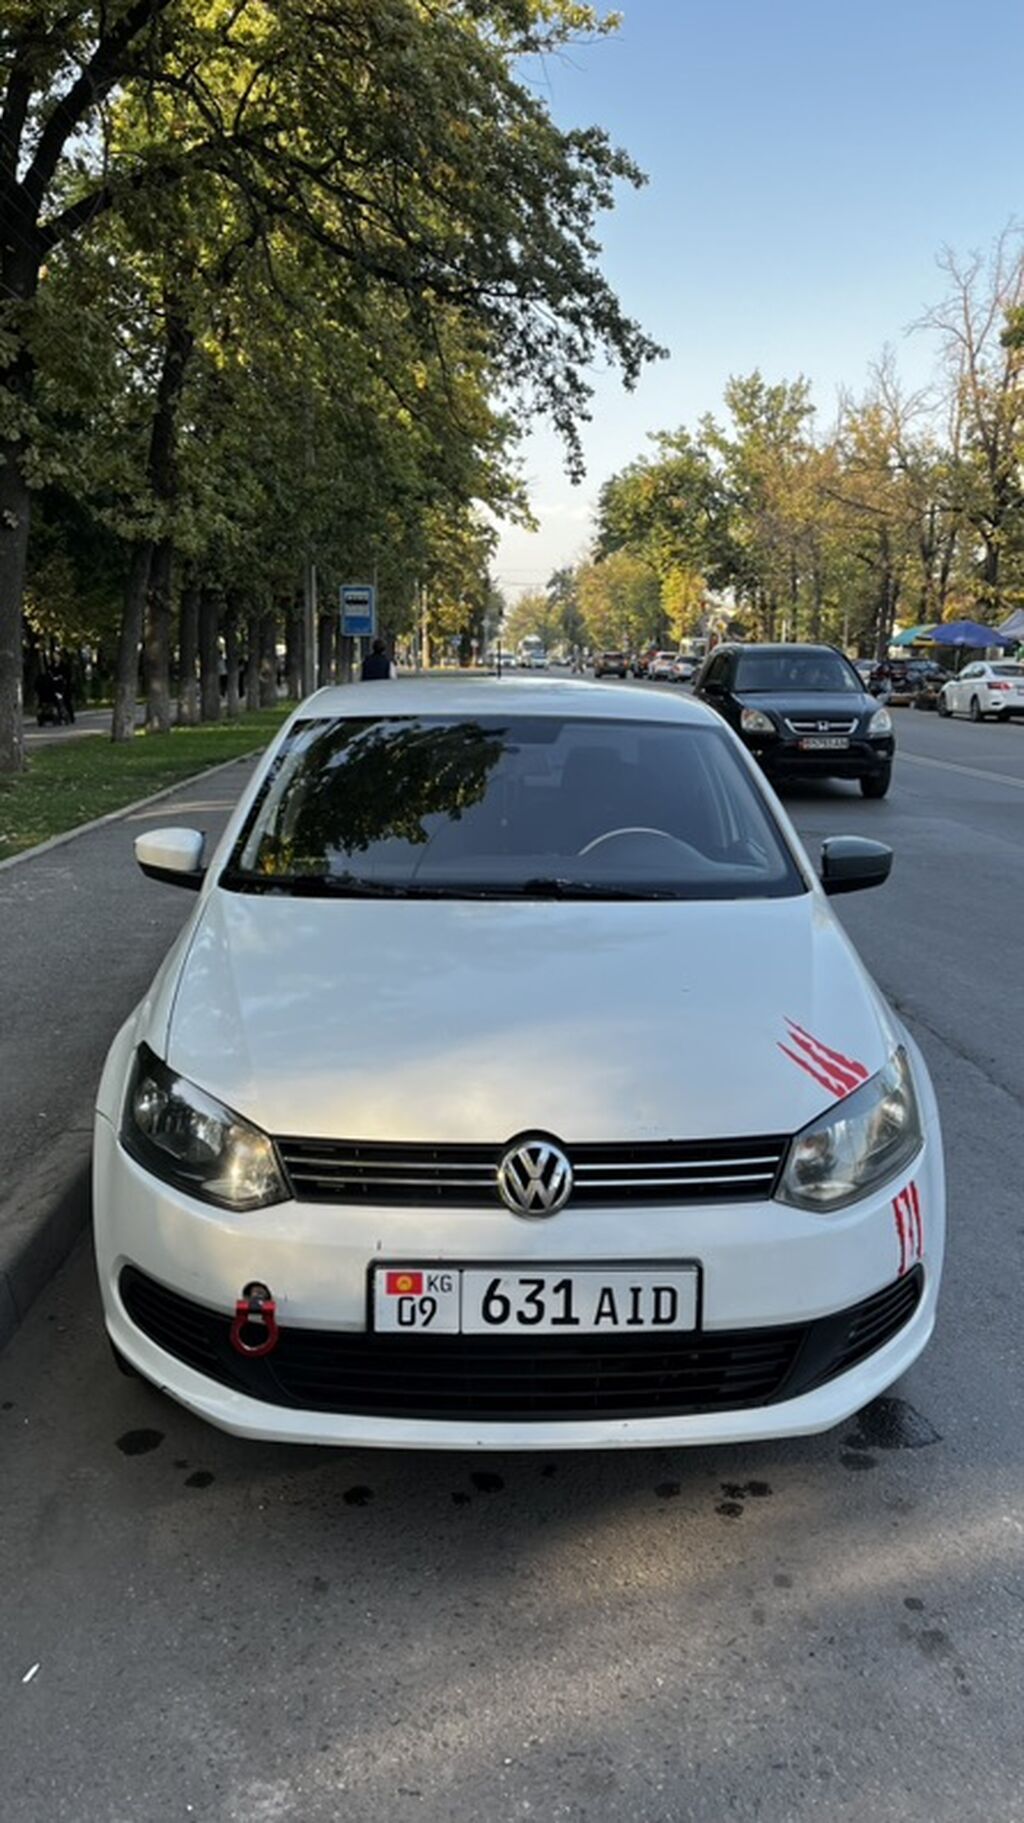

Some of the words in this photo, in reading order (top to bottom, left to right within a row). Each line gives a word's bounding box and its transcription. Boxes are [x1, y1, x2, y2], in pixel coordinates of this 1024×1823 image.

[426, 1275, 453, 1293] KG
[397, 1296, 437, 1327] 09
[481, 1278, 580, 1325] 631
[594, 1287, 678, 1325] AID
